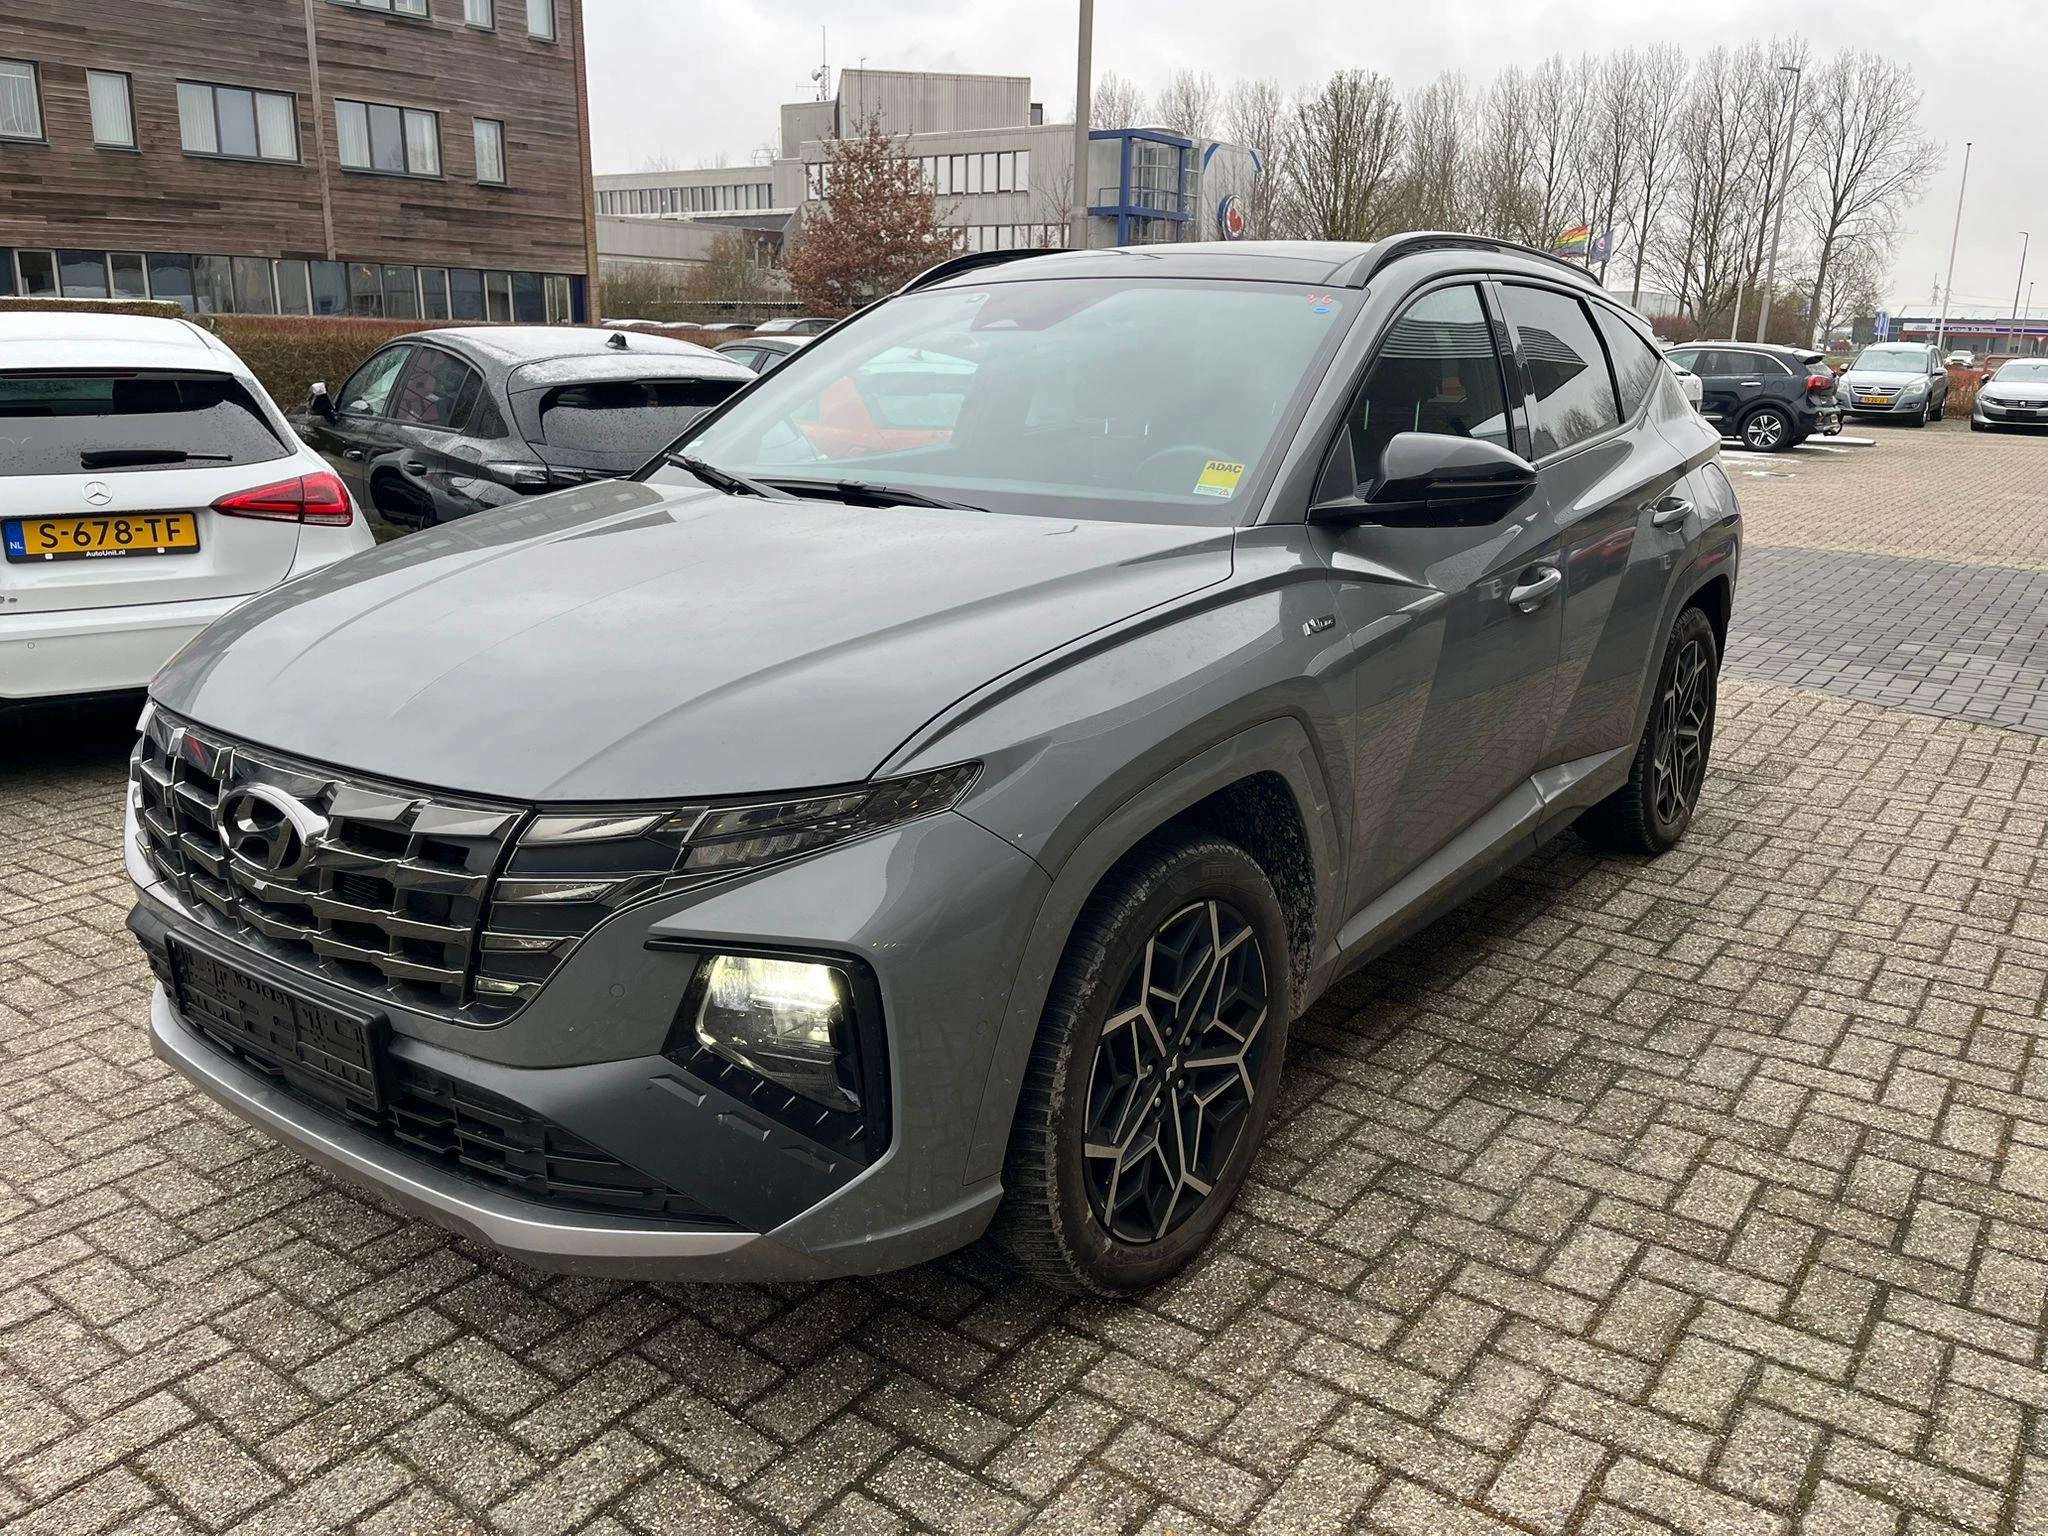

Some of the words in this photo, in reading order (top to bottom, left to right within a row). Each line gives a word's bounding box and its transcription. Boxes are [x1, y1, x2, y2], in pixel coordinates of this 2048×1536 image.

[1206, 462, 1242, 473] ADAC
[39, 517, 181, 549] S-678-TF
[9, 541, 24, 550] NL
[85, 549, 126, 558] AutoUnit.nl
